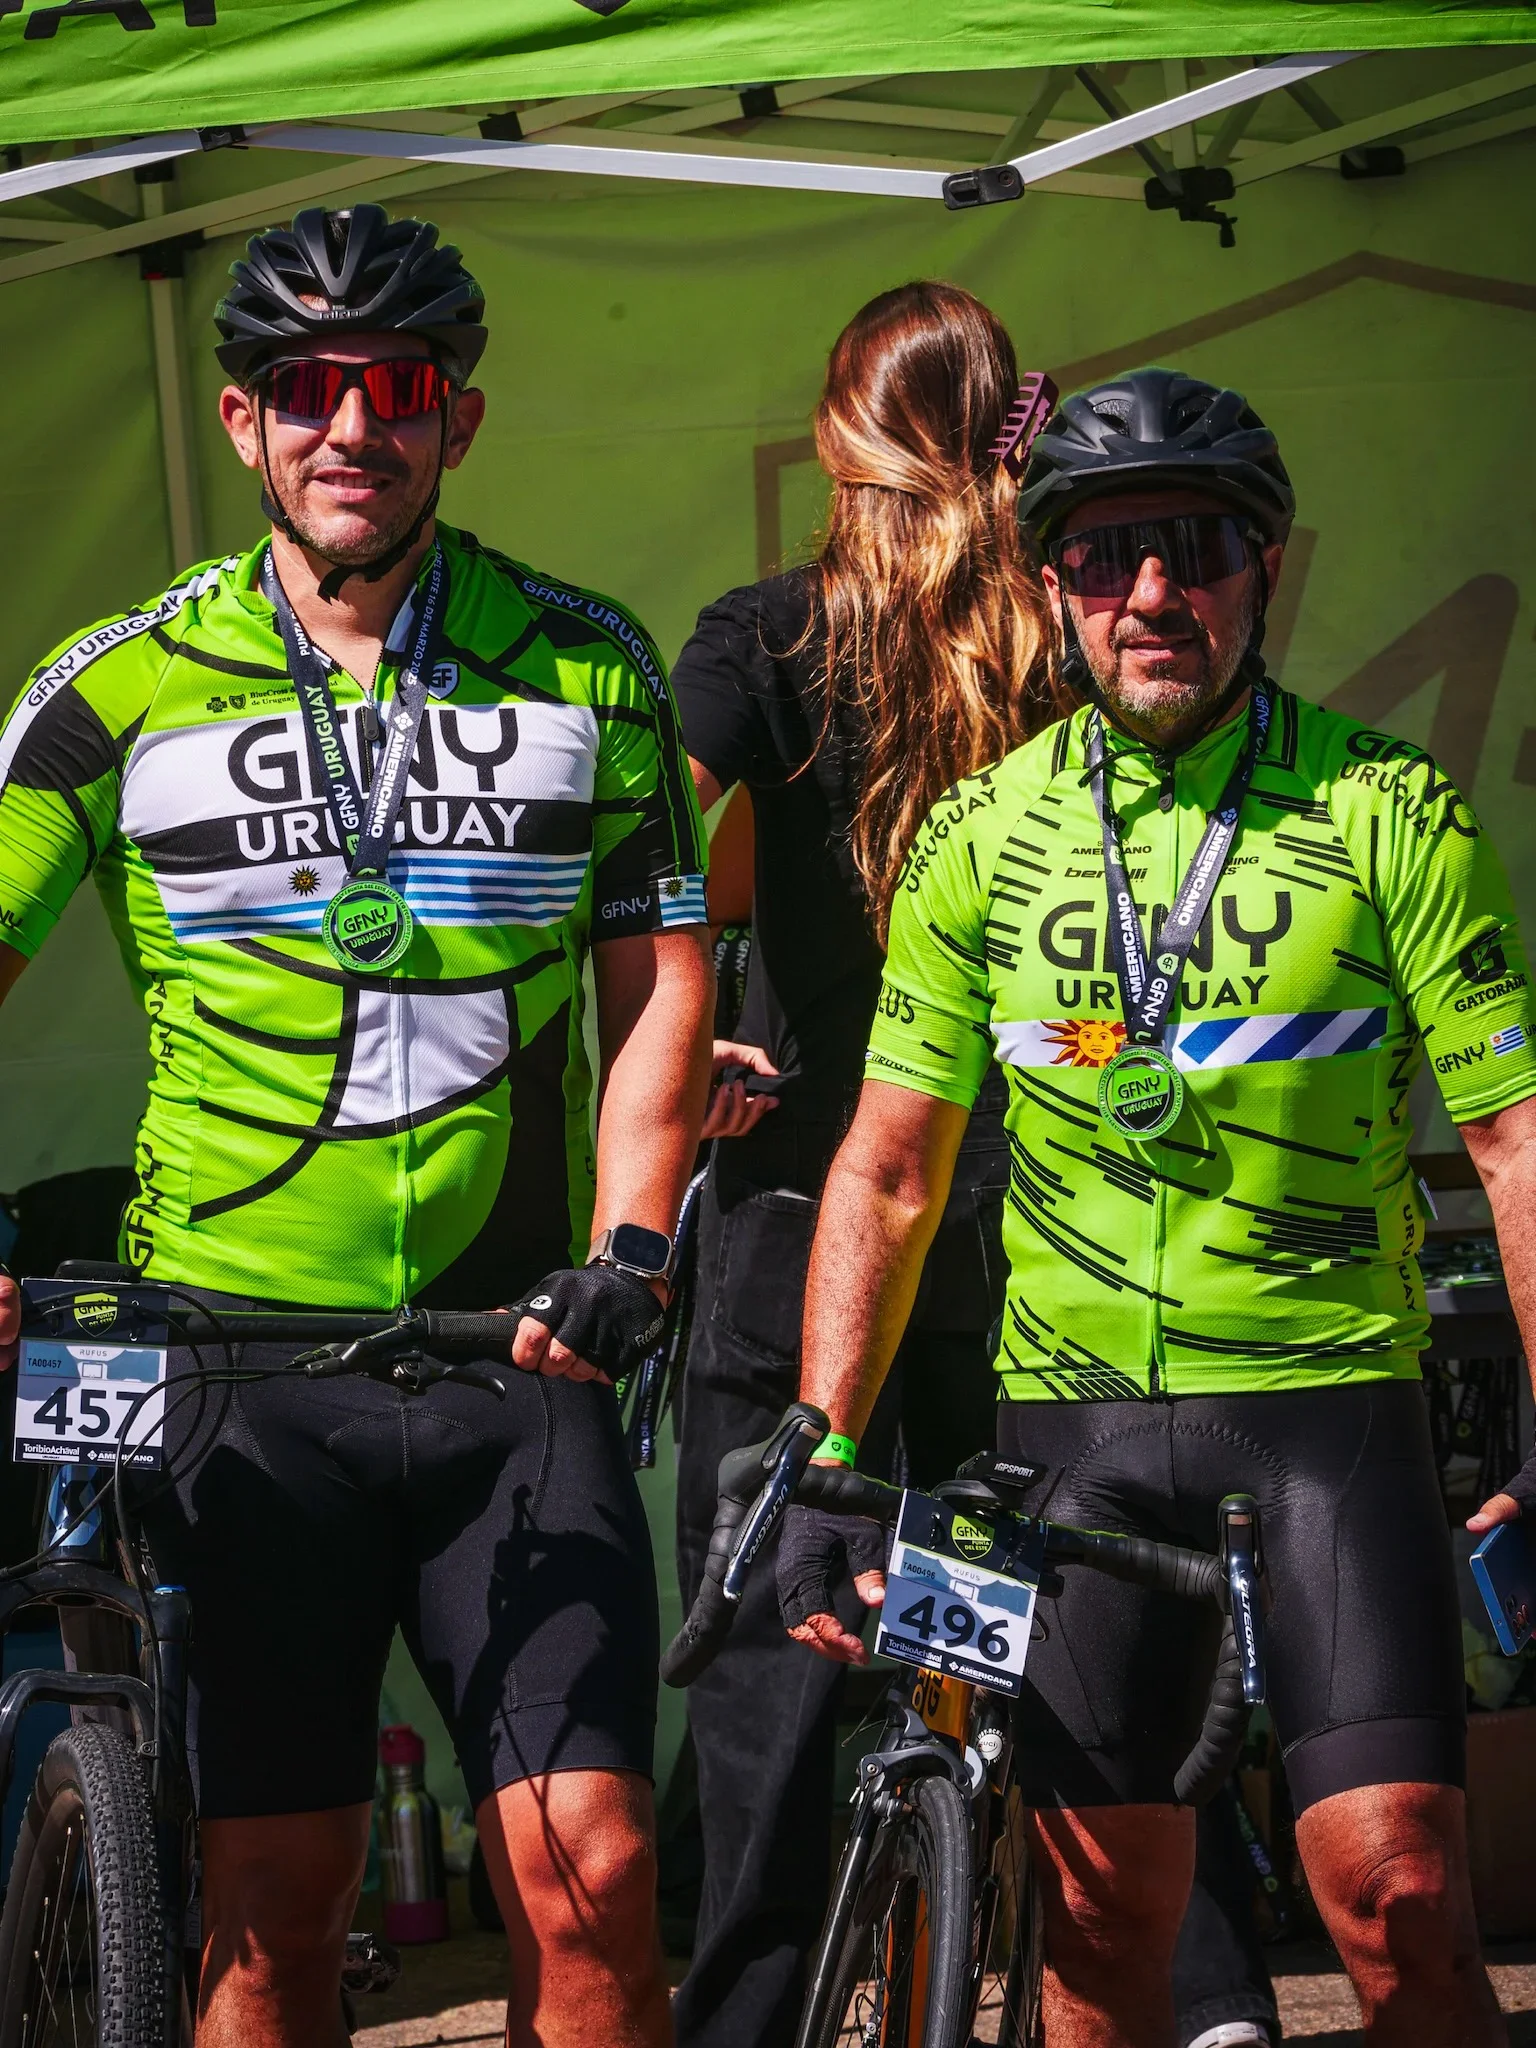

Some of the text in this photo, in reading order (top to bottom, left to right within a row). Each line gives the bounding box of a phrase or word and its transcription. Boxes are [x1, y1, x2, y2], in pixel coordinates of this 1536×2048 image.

[431, 570, 441, 595] ESTE
[424, 607, 434, 621] DE
[427, 595, 436, 607] 16
[413, 622, 430, 660] MARZO
[522, 579, 667, 701] GFNY URUGUAY
[28, 655, 75, 707] GFNY
[407, 660, 421, 686] 2025
[249, 687, 288, 699] BlueCross
[262, 696, 296, 706] Uruguay
[227, 708, 519, 804] GNY
[304, 685, 360, 831] GFNY URUGUAY
[370, 730, 406, 839] AMERICANO
[1339, 760, 1437, 839] URUGUA
[235, 800, 526, 862] URUAY
[906, 787, 997, 894] URUGUAY
[1070, 845, 1153, 856] AMEANO
[1064, 867, 1149, 879] berlli
[1177, 824, 1231, 927] AMERICANO
[0, 904, 24, 929] NY
[343, 905, 389, 934] GFNY
[601, 895, 651, 920] GFNY
[349, 926, 392, 948] URUGUAY
[1039, 891, 1293, 974] GNY
[1117, 891, 1144, 1004] AMERICANO
[1056, 974, 1270, 1011] URUAY
[1140, 977, 1168, 1027] GFNY
[1454, 973, 1528, 1013] GATORADE
[1435, 1041, 1486, 1075] GFNY
[1117, 1074, 1160, 1099] GFNY
[1122, 1095, 1164, 1116] URUGUAY
[27, 1357, 62, 1369] TA00457
[79, 1349, 108, 1357] RUFUS
[33, 1386, 147, 1439] 457
[639, 1438, 651, 1467] PUNTA
[744, 1483, 789, 1564] ULTEGRA
[956, 1526, 988, 1539] GFNY
[902, 1561, 936, 1580] TA00496
[953, 1567, 981, 1582] RUFUS
[898, 1594, 1010, 1663] 496
[1239, 1577, 1257, 1669] ULTEGRA
[958, 1665, 1014, 1688] AMERICANO
